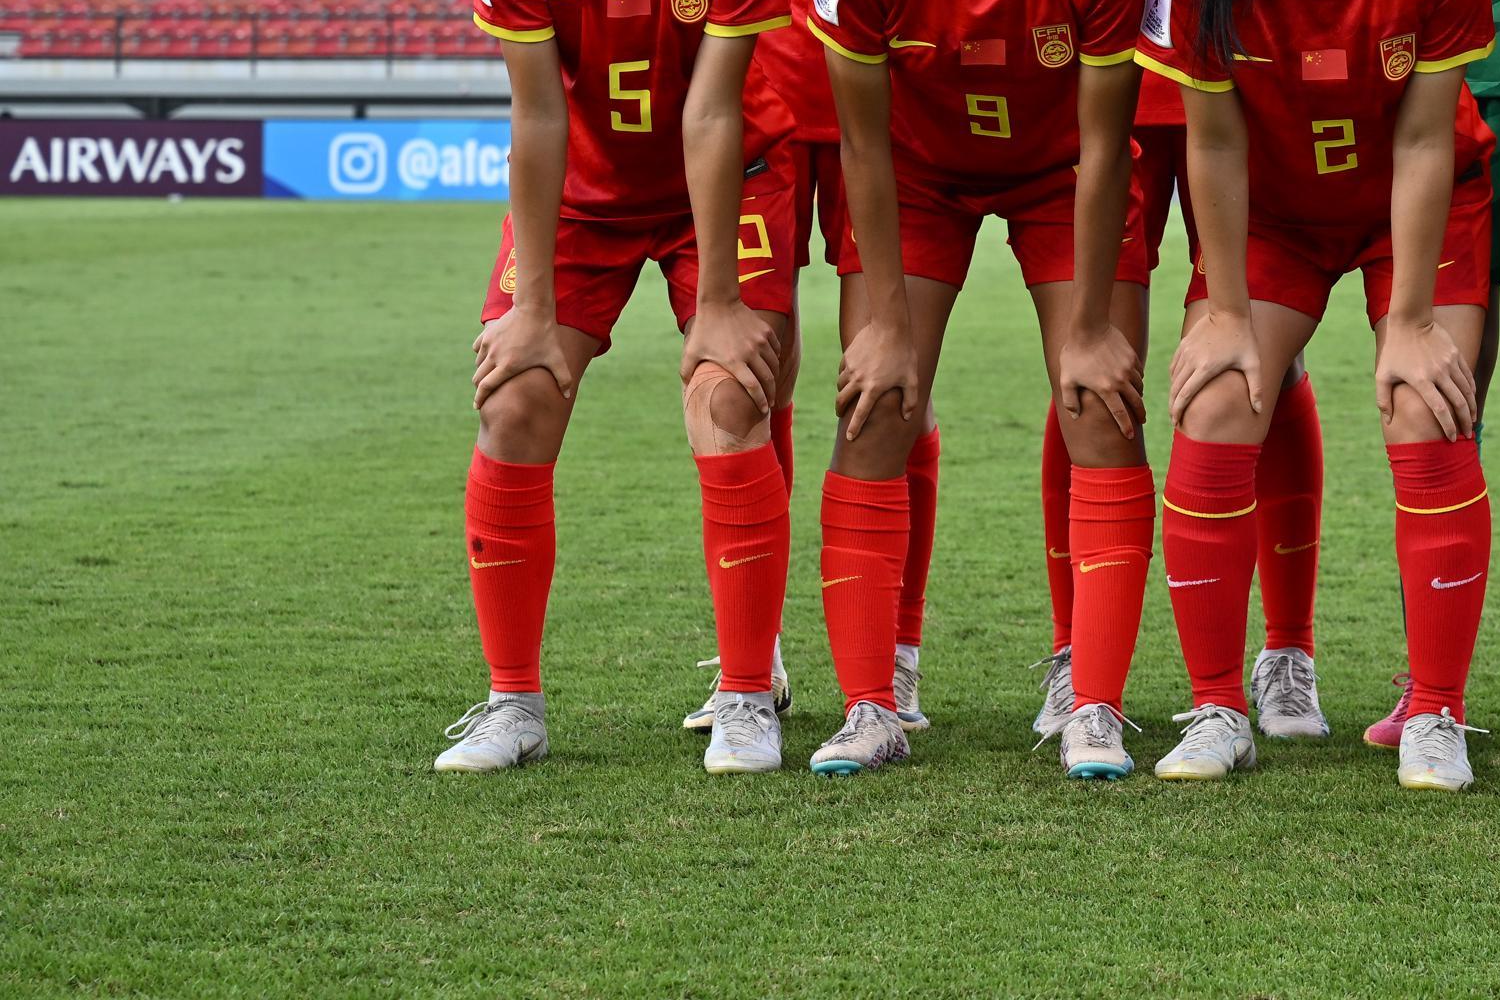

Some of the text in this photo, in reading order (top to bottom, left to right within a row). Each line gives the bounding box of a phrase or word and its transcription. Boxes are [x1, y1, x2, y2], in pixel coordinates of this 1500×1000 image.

[1036, 26, 1067, 37] CFA
[1383, 36, 1412, 51] CFA
[609, 60, 652, 132] 5
[966, 94, 1011, 138] 9
[9, 136, 246, 184] AIRWAYS
[1312, 119, 1358, 174] 2
